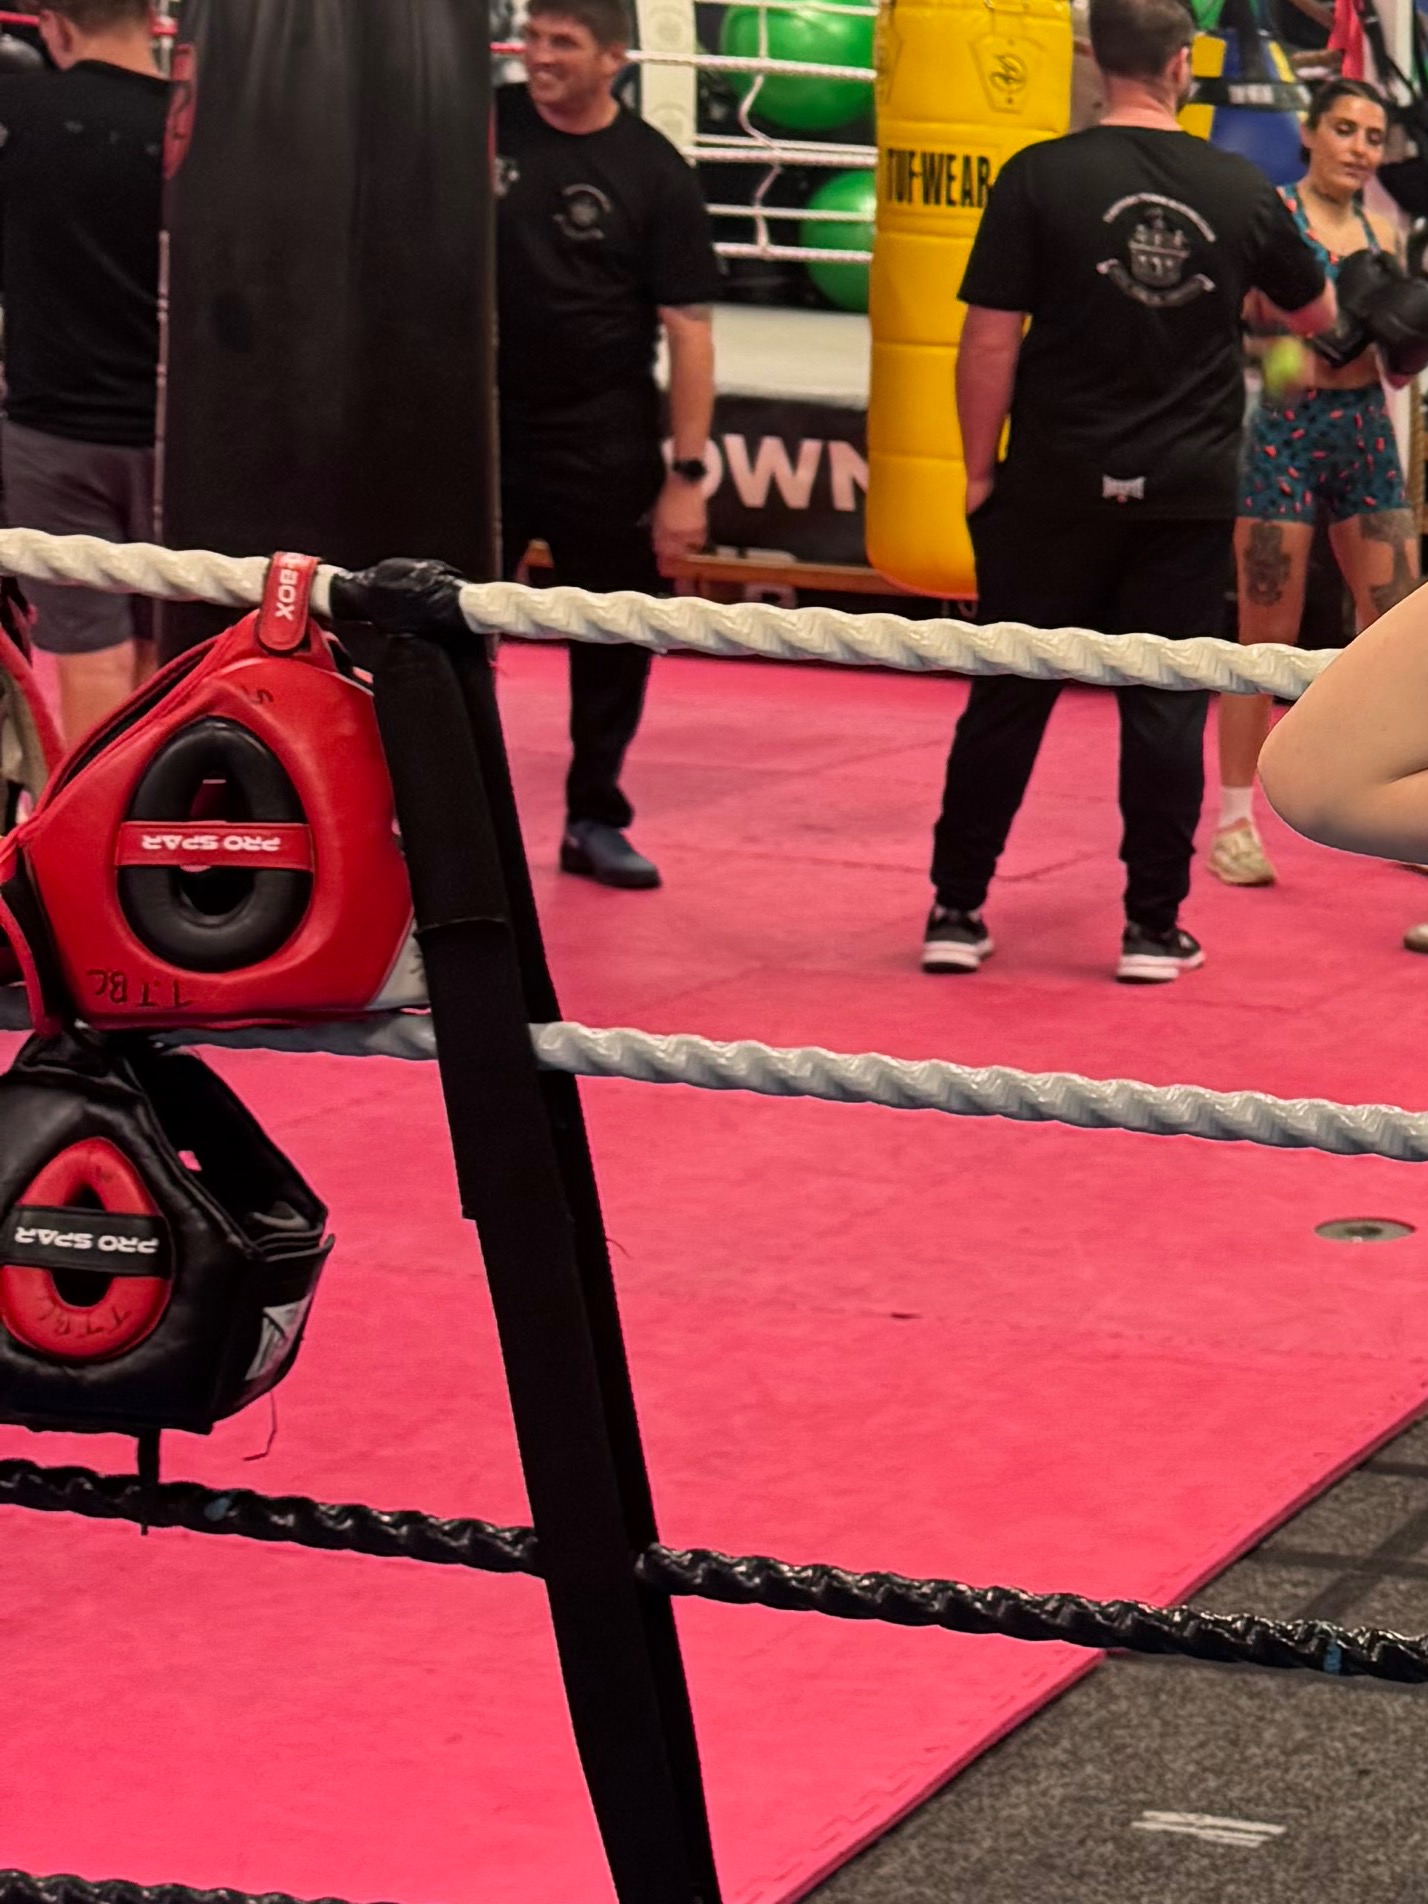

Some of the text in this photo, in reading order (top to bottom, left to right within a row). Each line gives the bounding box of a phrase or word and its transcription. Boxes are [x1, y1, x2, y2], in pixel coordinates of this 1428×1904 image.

[887, 147, 992, 209] TUF-WEAR
[661, 433, 869, 512] OWN
[141, 834, 282, 852] PRO SPAR
[14, 1226, 160, 1254] PRO SPAR
